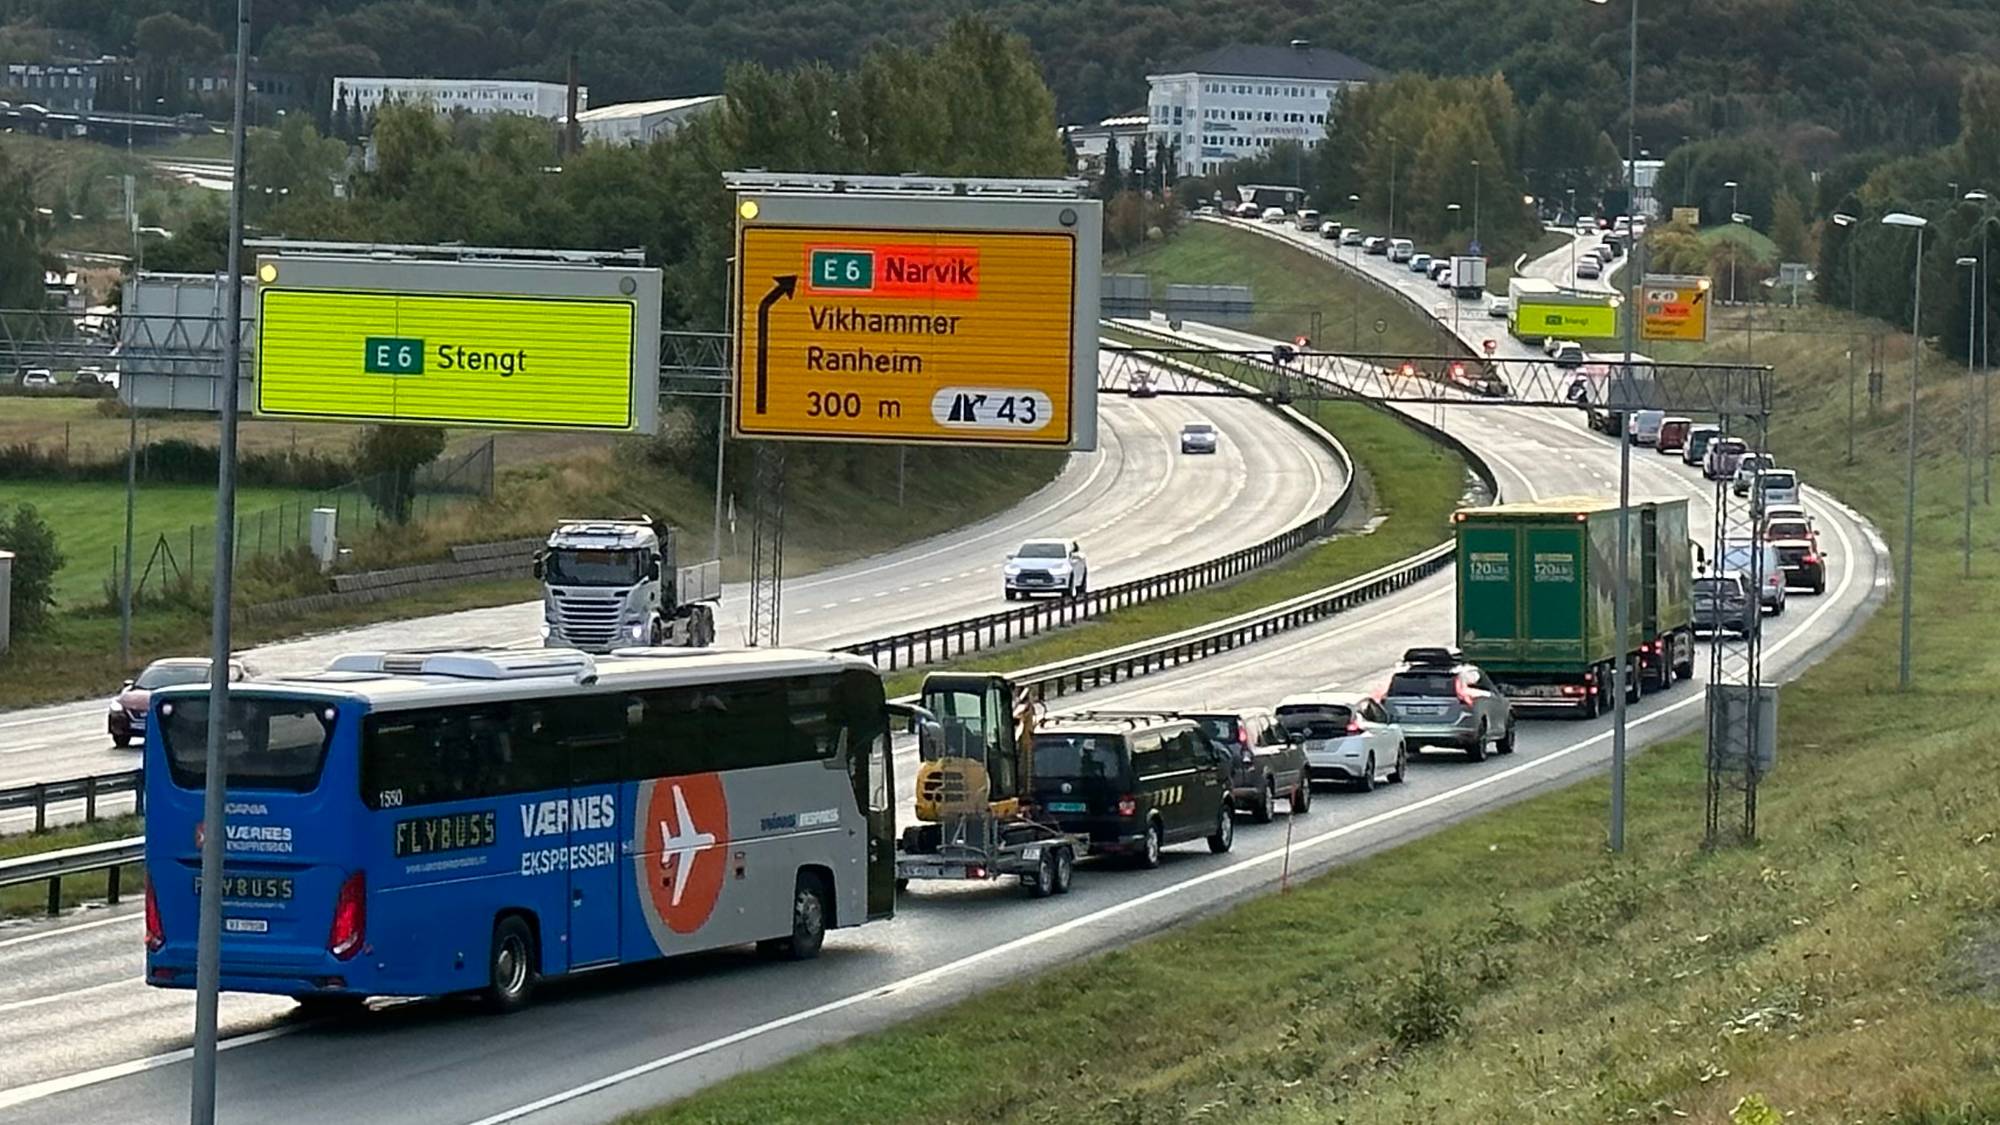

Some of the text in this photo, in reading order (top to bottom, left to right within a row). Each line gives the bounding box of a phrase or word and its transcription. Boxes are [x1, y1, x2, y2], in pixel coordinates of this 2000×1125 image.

[885, 256, 974, 286] Narvik
[809, 305, 962, 336] Vikhammer
[437, 344, 528, 377] Stengt
[807, 345, 922, 374] Ranheim
[807, 391, 901, 419] 300 m
[997, 396, 1037, 425] 43
[520, 793, 615, 839] VÆRNES
[396, 812, 495, 856] FLYBUSS
[520, 840, 615, 877] EKSPRESSEN
[194, 876, 292, 899] FYBUSS
